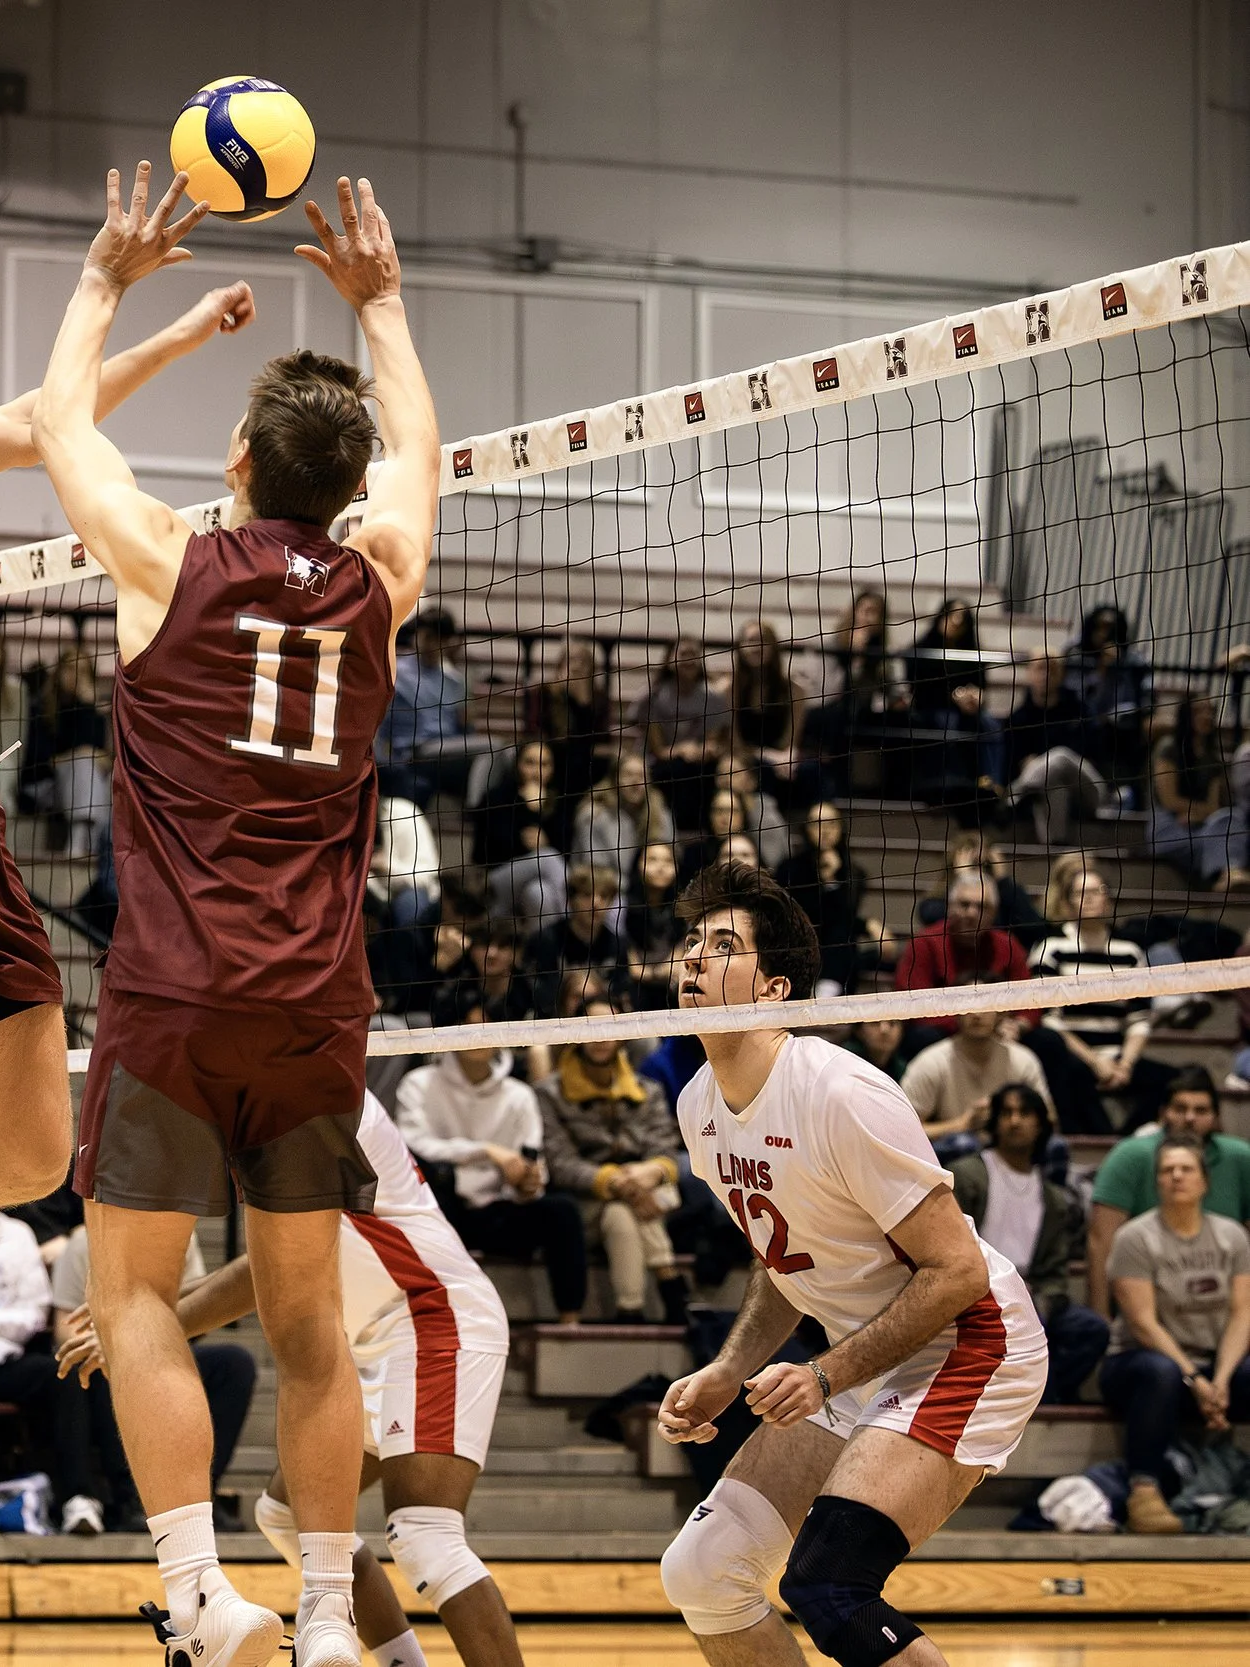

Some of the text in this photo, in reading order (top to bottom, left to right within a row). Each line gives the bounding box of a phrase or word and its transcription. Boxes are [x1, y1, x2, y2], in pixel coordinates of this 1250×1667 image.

[225, 138, 250, 164] FIVB
[817, 380, 836, 390] TEAM
[226, 612, 352, 770] 11
[765, 1135, 794, 1149] OUA
[728, 1188, 815, 1274] 12
